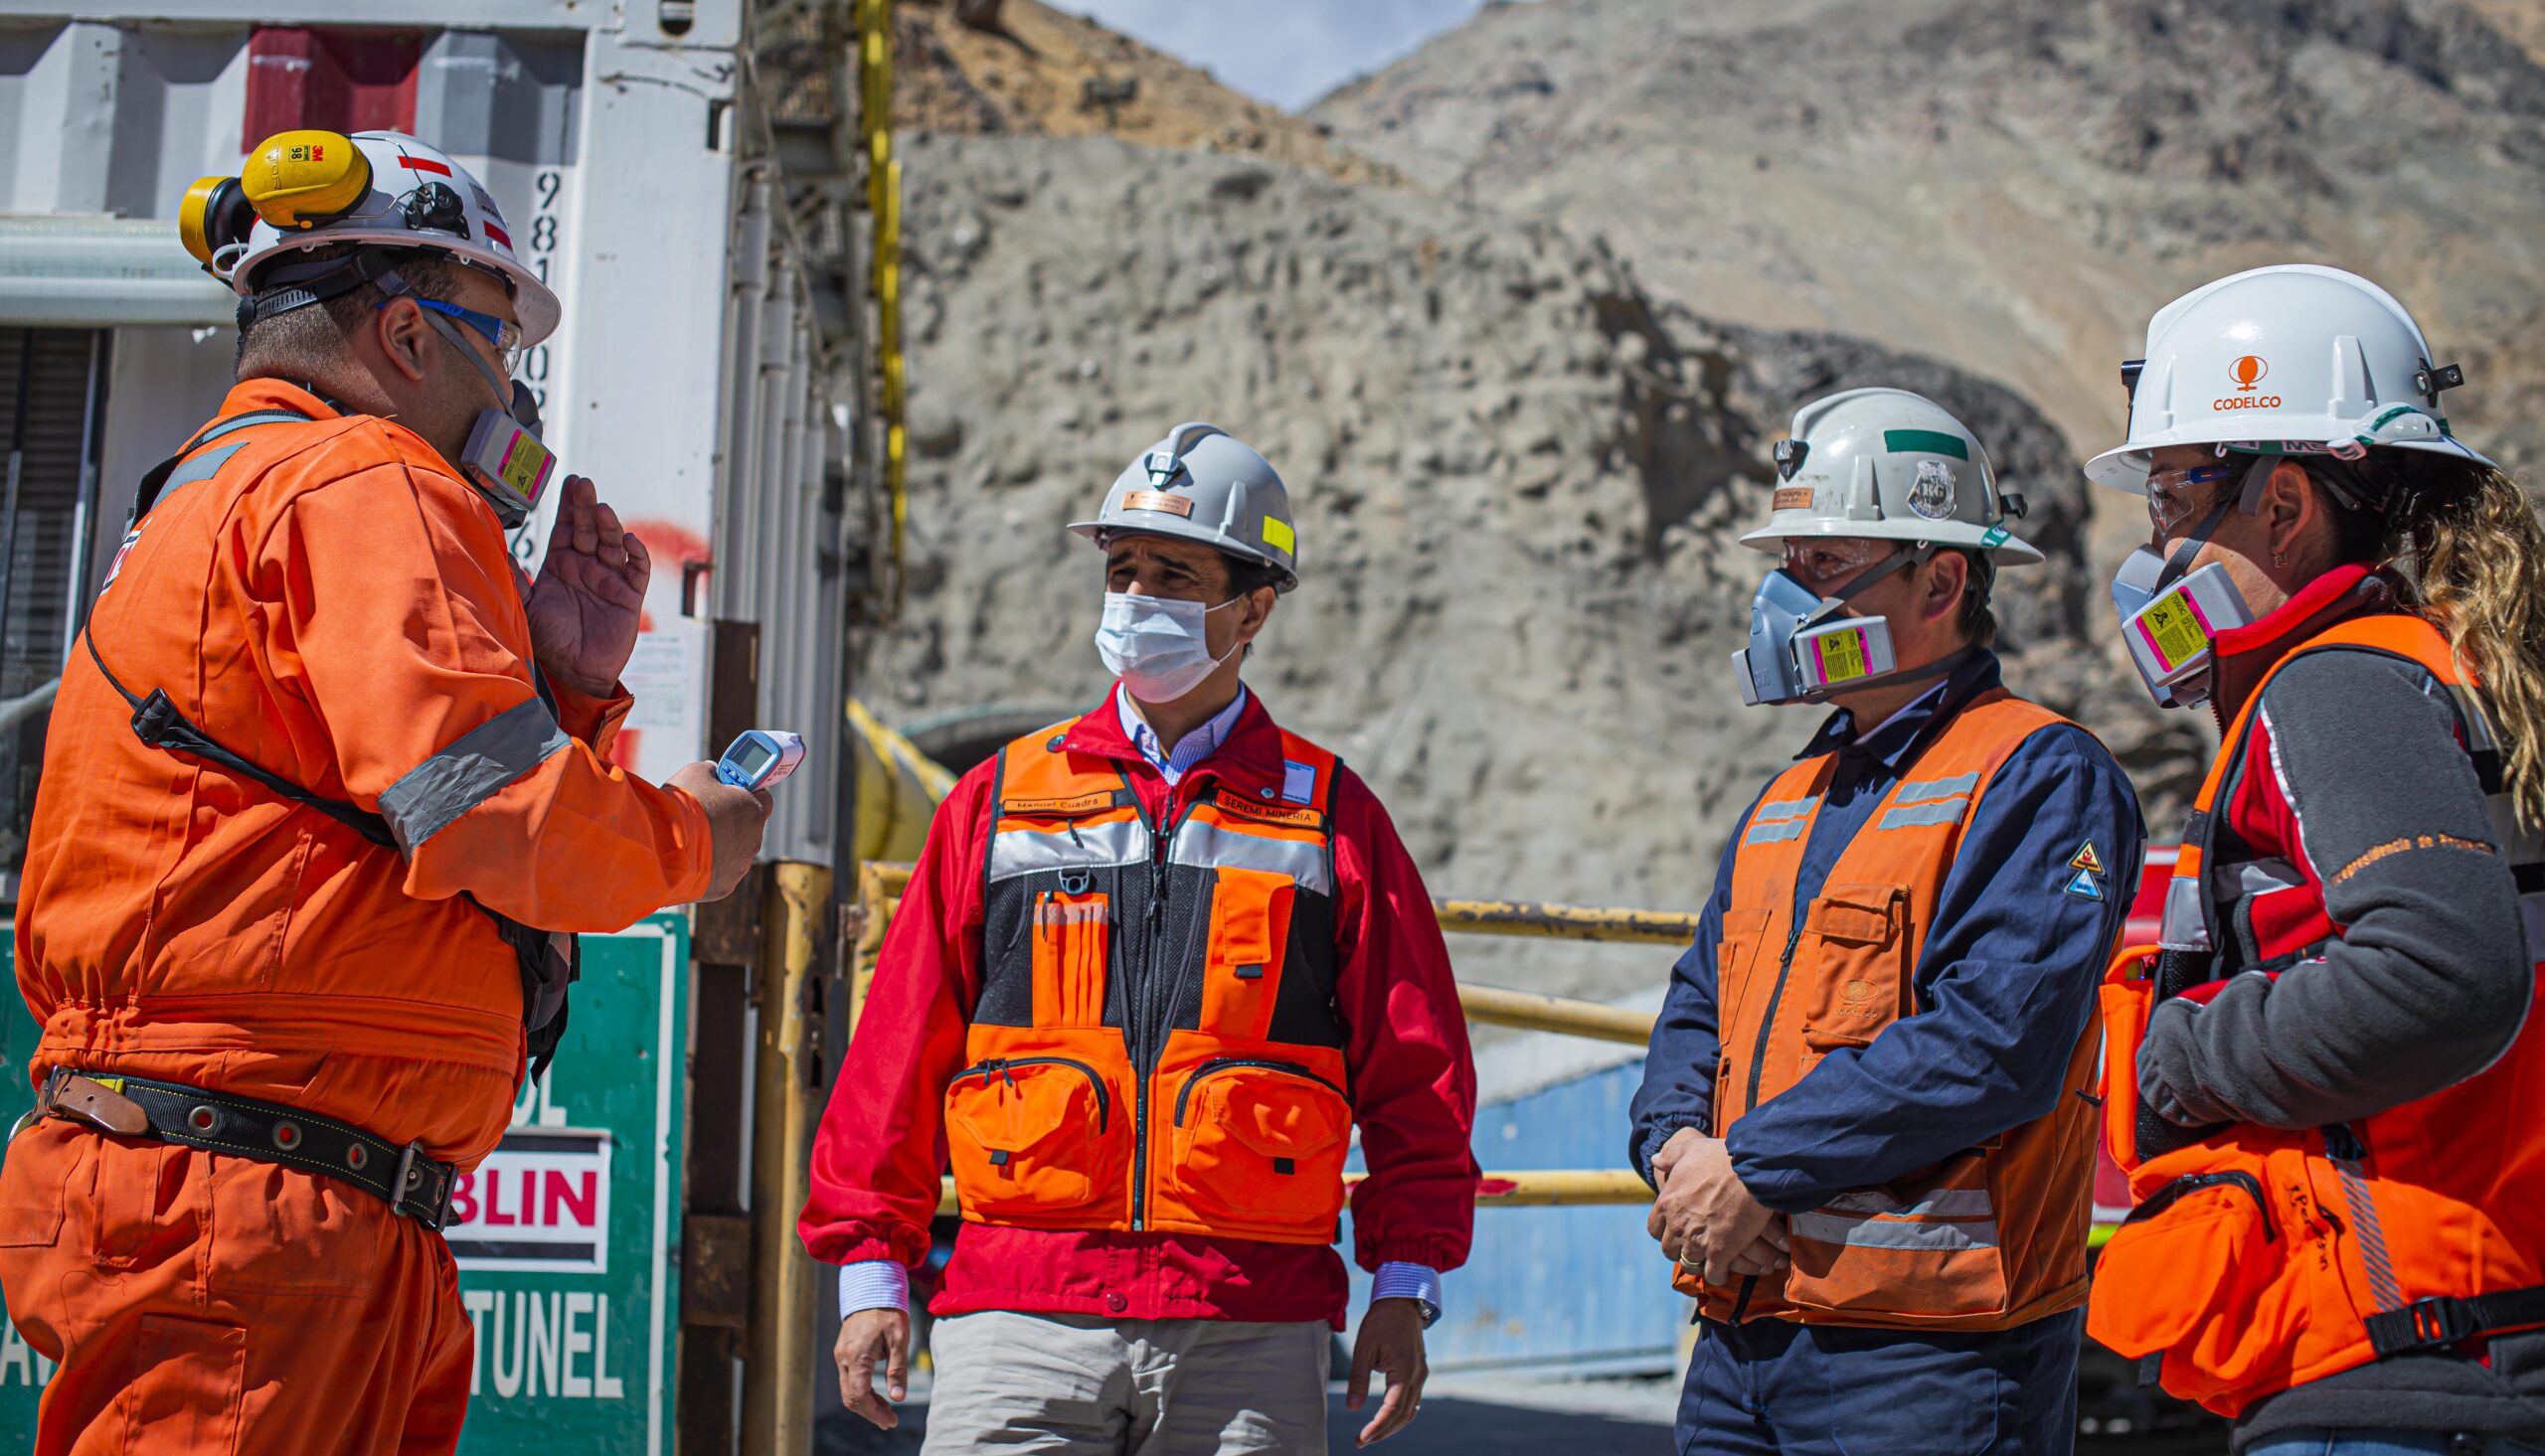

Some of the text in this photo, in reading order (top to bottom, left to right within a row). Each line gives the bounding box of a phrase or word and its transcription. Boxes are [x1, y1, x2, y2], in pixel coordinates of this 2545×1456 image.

[290, 147, 303, 159] 98
[311, 145, 324, 162] 3M
[2213, 396, 2282, 410] CODELCO
[1060, 798, 1099, 810] Cuadra
[1224, 796, 1311, 823] SEREMI MINERIA
[463, 1289, 624, 1398] TUNEL
